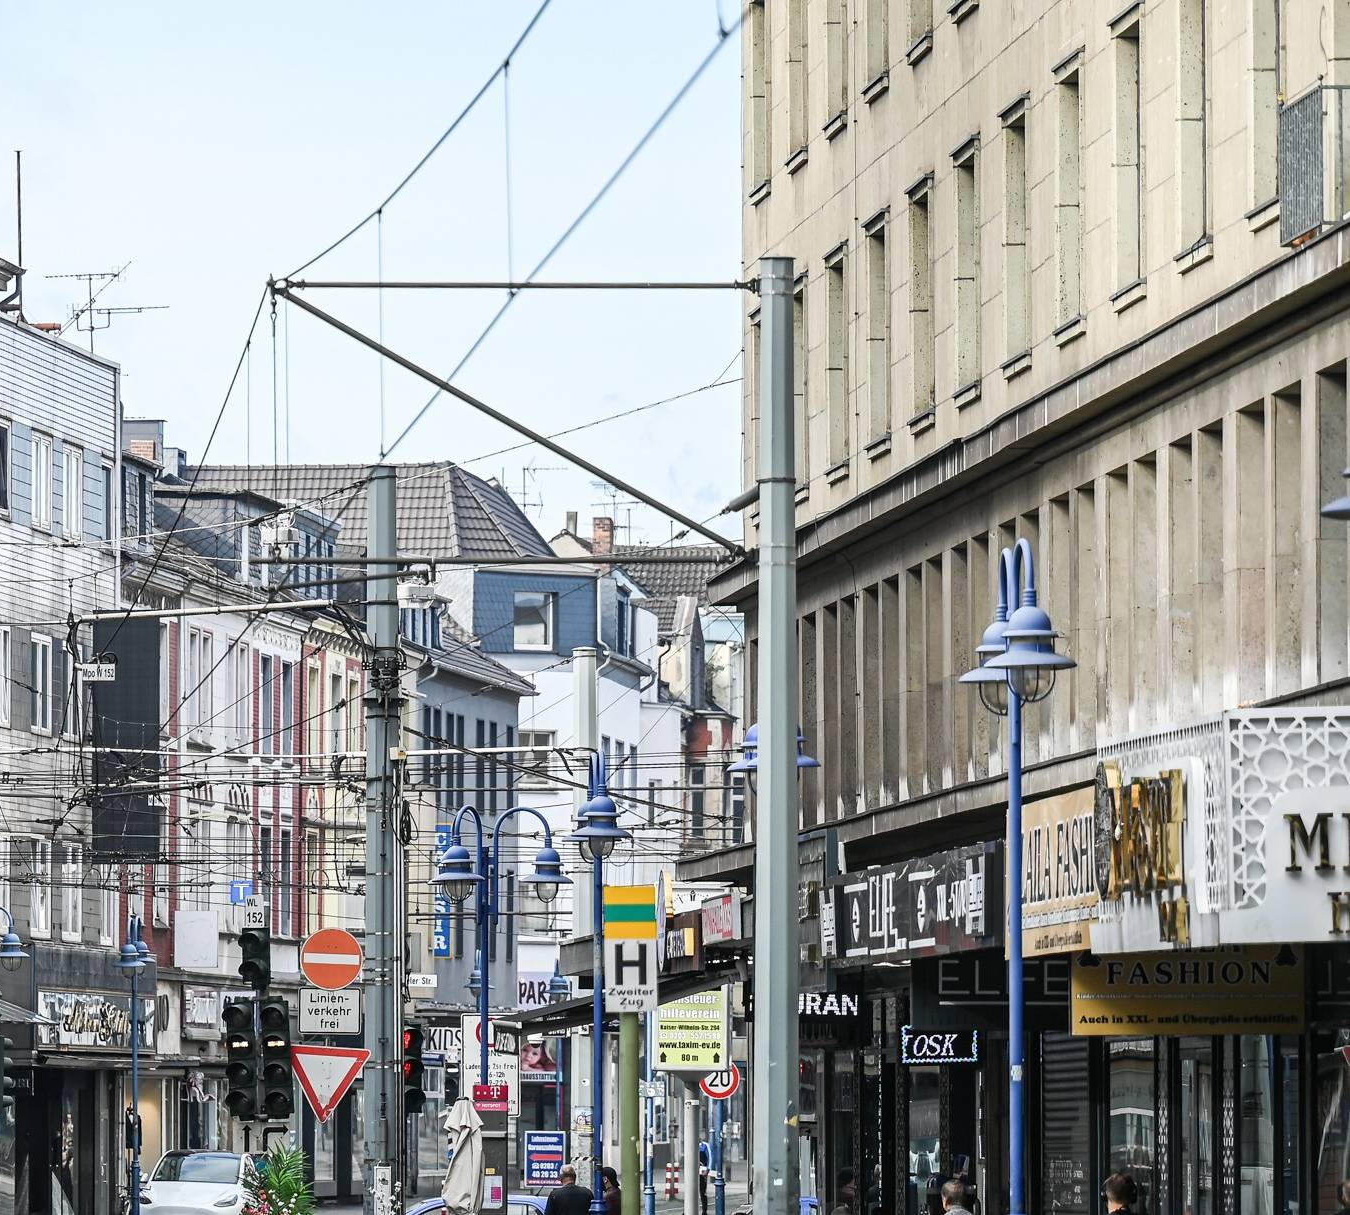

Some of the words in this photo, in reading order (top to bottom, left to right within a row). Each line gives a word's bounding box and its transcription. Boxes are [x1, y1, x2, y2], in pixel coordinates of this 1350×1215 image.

[83, 669, 96, 679] Mpo
[97, 669, 103, 678] W
[105, 669, 115, 678] 152
[1023, 824, 1052, 905] AILA
[246, 898, 258, 907] WL
[246, 911, 263, 924] 152
[615, 943, 647, 986] H
[1106, 961, 1272, 986] FASHION
[421, 976, 433, 985] Str.
[608, 988, 655, 996] Zweiter
[310, 993, 349, 1004] Linien-
[620, 998, 644, 1007] Zug
[307, 1006, 352, 1016] verkehr
[659, 1006, 720, 1020] hilfeverein
[320, 1018, 339, 1029] frei
[1079, 1014, 1108, 1025] Auch
[1111, 1014, 1124, 1025] in
[1126, 1015, 1154, 1025] XXL-
[1157, 1015, 1179, 1025] und
[430, 1029, 461, 1051] KIDS
[658, 1040, 721, 1050] www.taxim-ev.de
[681, 1053, 691, 1062] 80
[708, 1072, 730, 1088] 20
